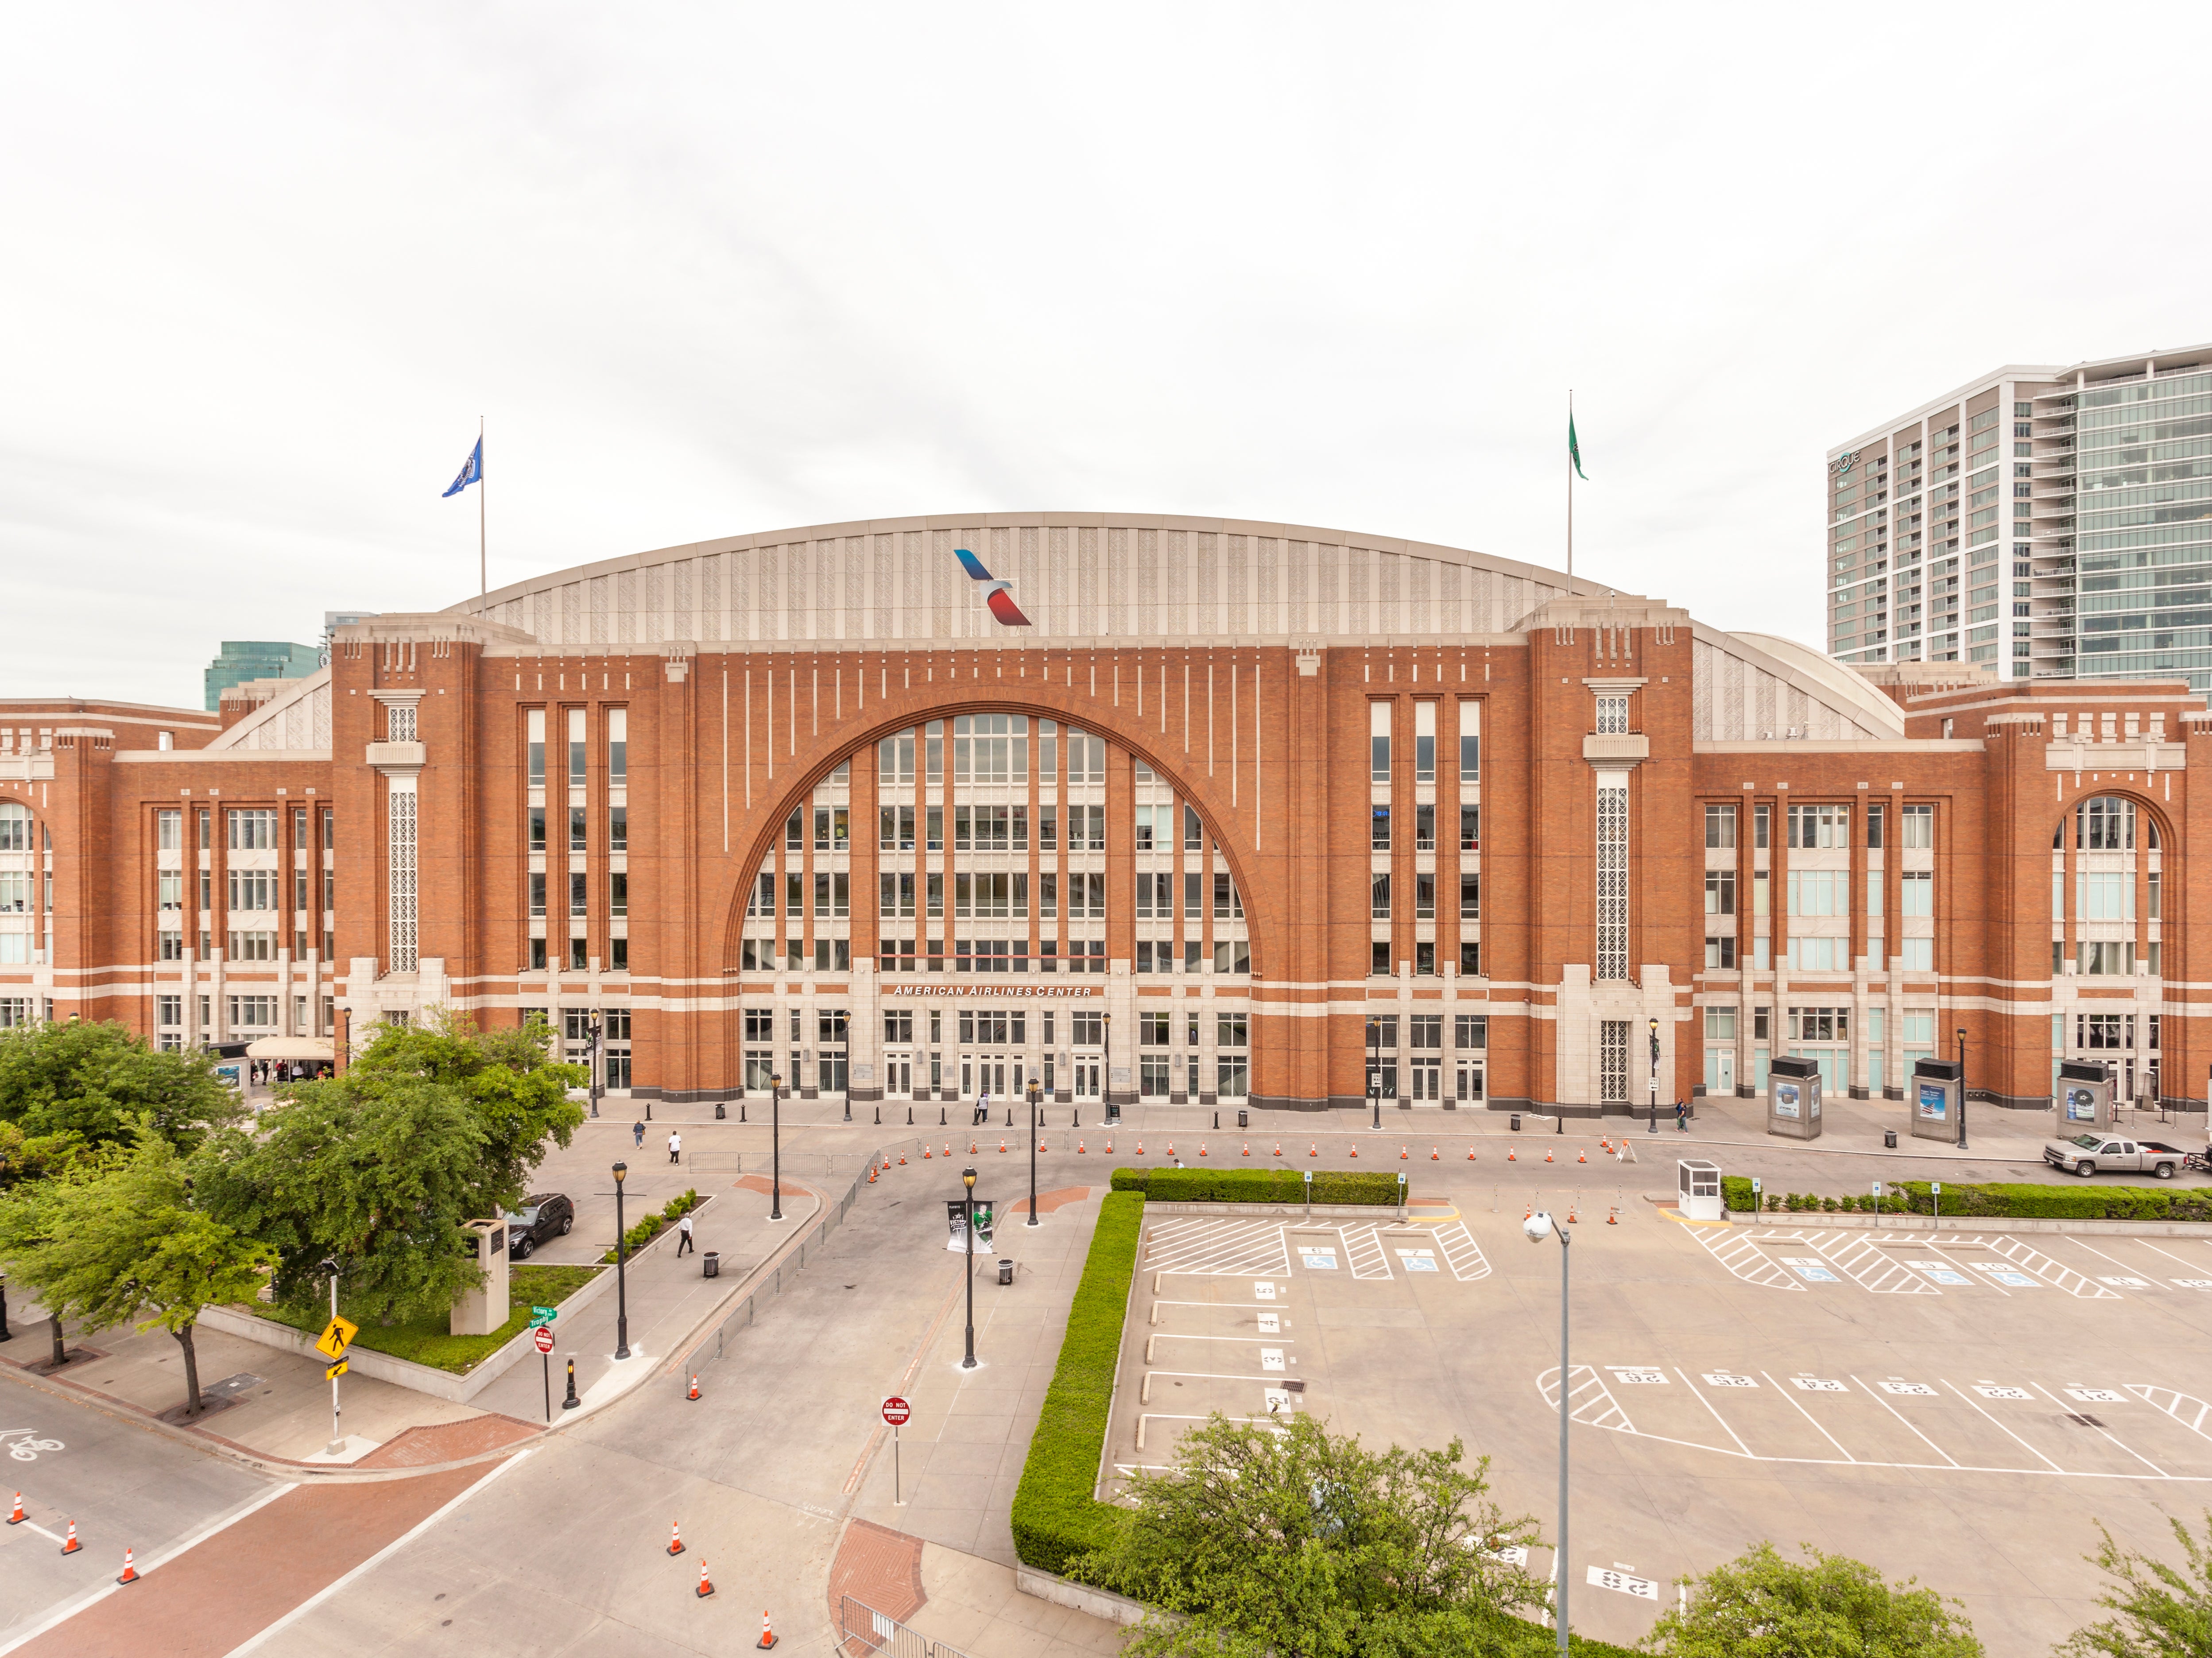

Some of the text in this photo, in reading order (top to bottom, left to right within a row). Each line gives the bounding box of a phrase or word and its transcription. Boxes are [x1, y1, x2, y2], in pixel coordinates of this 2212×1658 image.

[1829, 451, 1861, 473] CIRQUE
[894, 985, 1091, 996] AMERICAN AIRLINES CENTER
[533, 1306, 547, 1316] Victory
[531, 1316, 548, 1326] Trophy
[1625, 1373, 1660, 1382] 26
[1713, 1375, 1749, 1386] 25
[1801, 1379, 1839, 1390] 24
[1888, 1383, 1927, 1394] 23
[1981, 1387, 2022, 1398] 22
[2076, 1390, 2113, 1400] 21
[1602, 1572, 1648, 1596] 28
